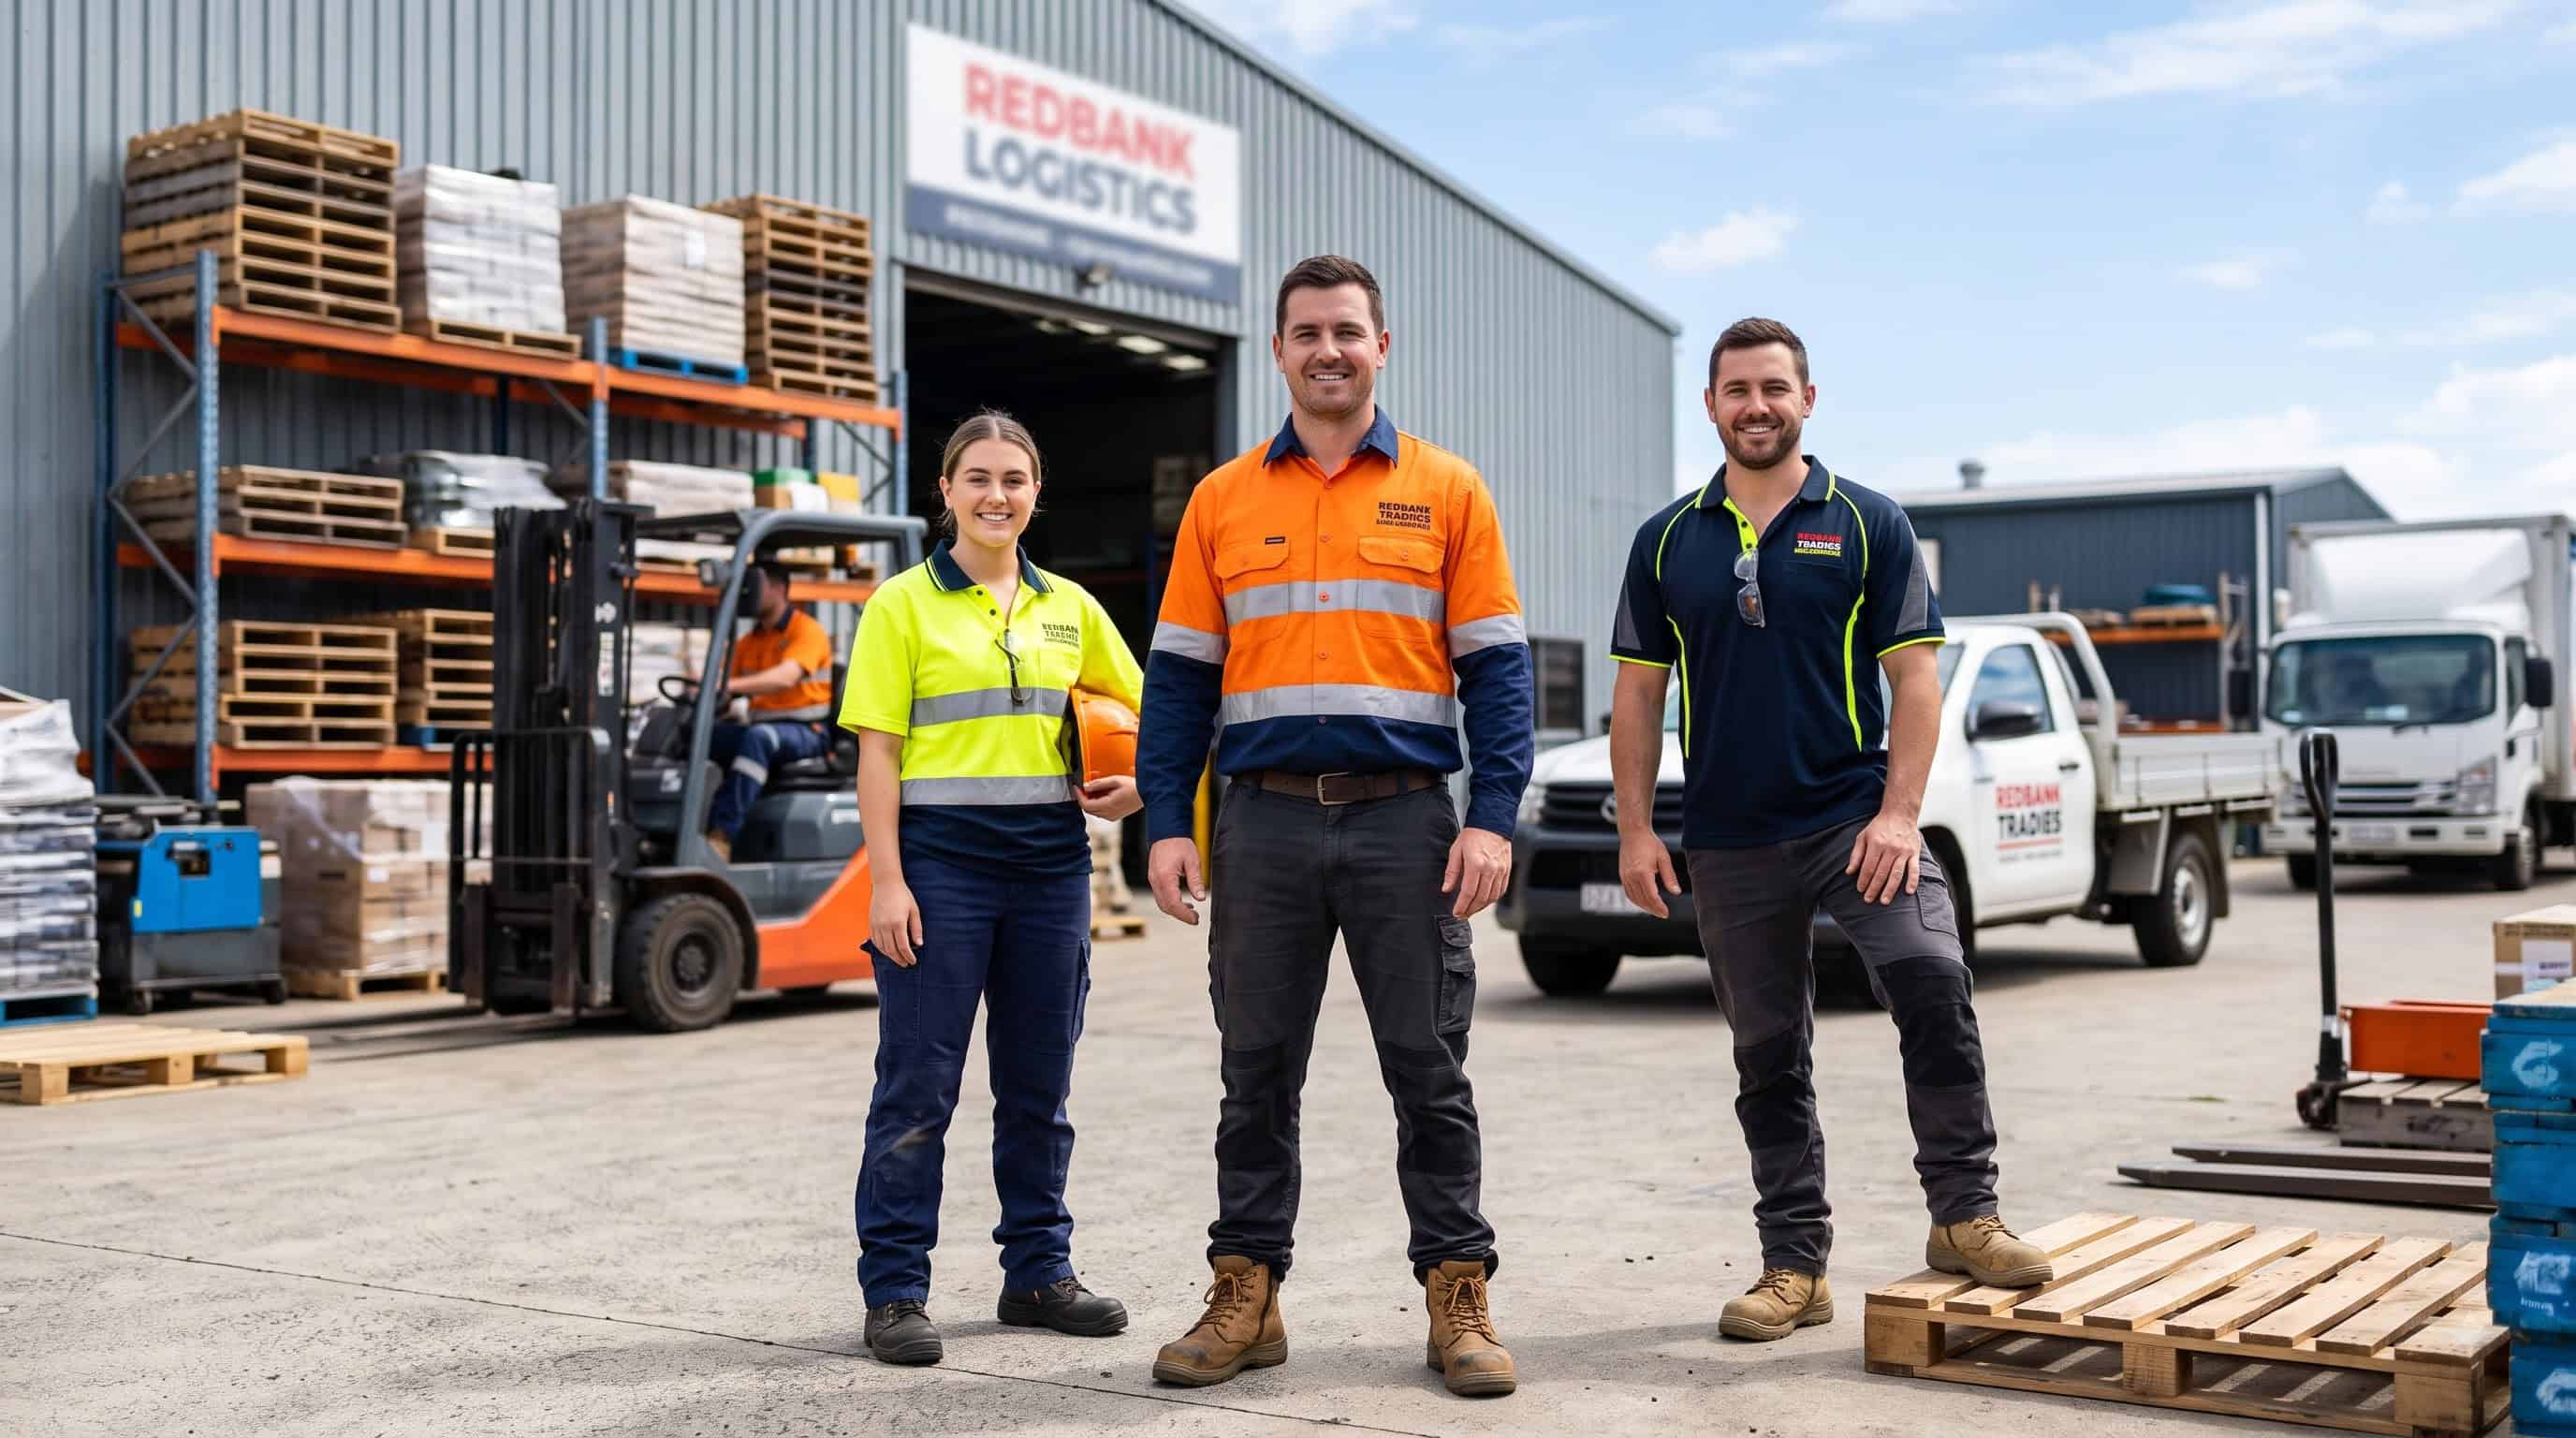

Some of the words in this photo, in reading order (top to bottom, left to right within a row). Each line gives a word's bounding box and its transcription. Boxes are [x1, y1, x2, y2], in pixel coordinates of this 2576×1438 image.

[964, 62, 1195, 181] REDBANK
[964, 127, 1197, 235] LOGISTICS
[1378, 502, 1431, 514] REDBANK
[1996, 783, 2061, 809] REDBANK
[1998, 810, 2062, 840] TRADIES
